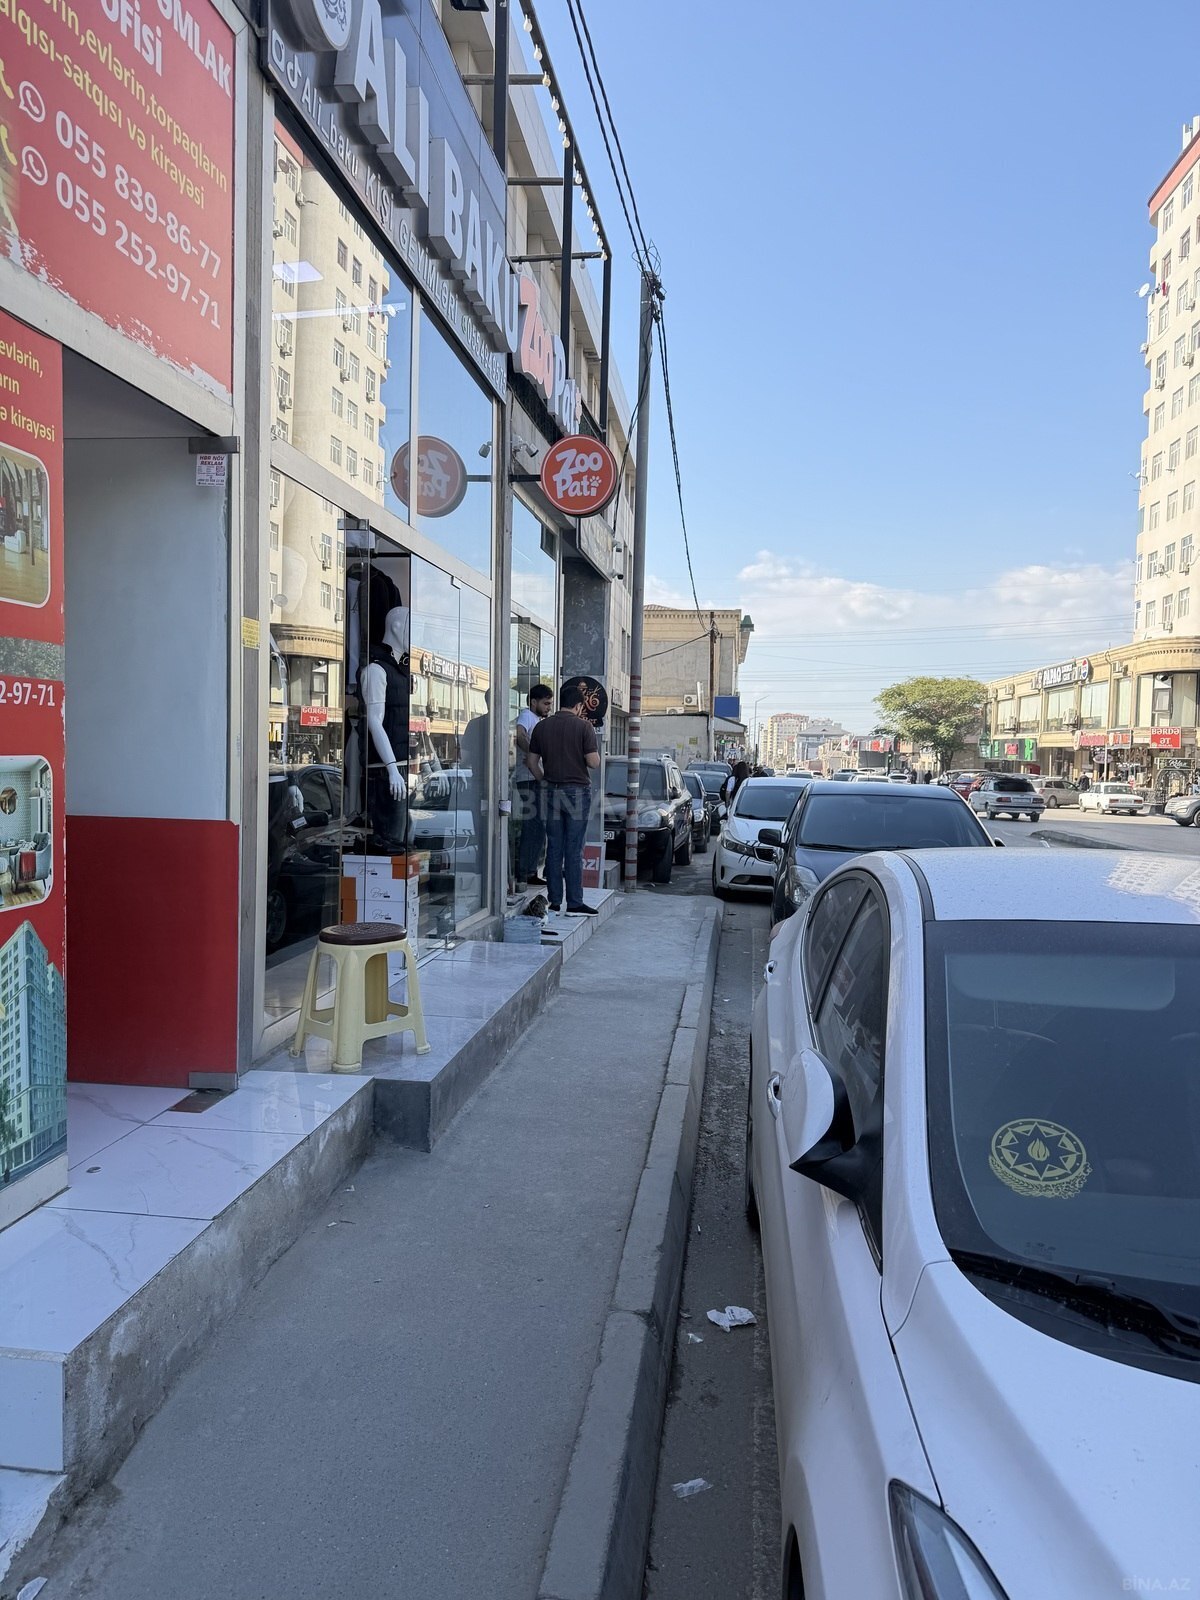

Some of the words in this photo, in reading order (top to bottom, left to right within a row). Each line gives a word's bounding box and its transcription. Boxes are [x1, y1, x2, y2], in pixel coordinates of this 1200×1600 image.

[56, 110, 107, 179] 055
[115, 164, 221, 278] 839-86-77
[128, 117, 147, 150] və
[151, 134, 204, 209] kirayəsi
[56, 172, 107, 236] 055
[115, 220, 221, 329] 252-97-71
[440, 137, 519, 354] BAKU
[11, 405, 55, 442] kirayəsi
[552, 472, 602, 499] Pati
[555, 449, 603, 473] Zoo
[0, 680, 55, 706] 2-97-71
